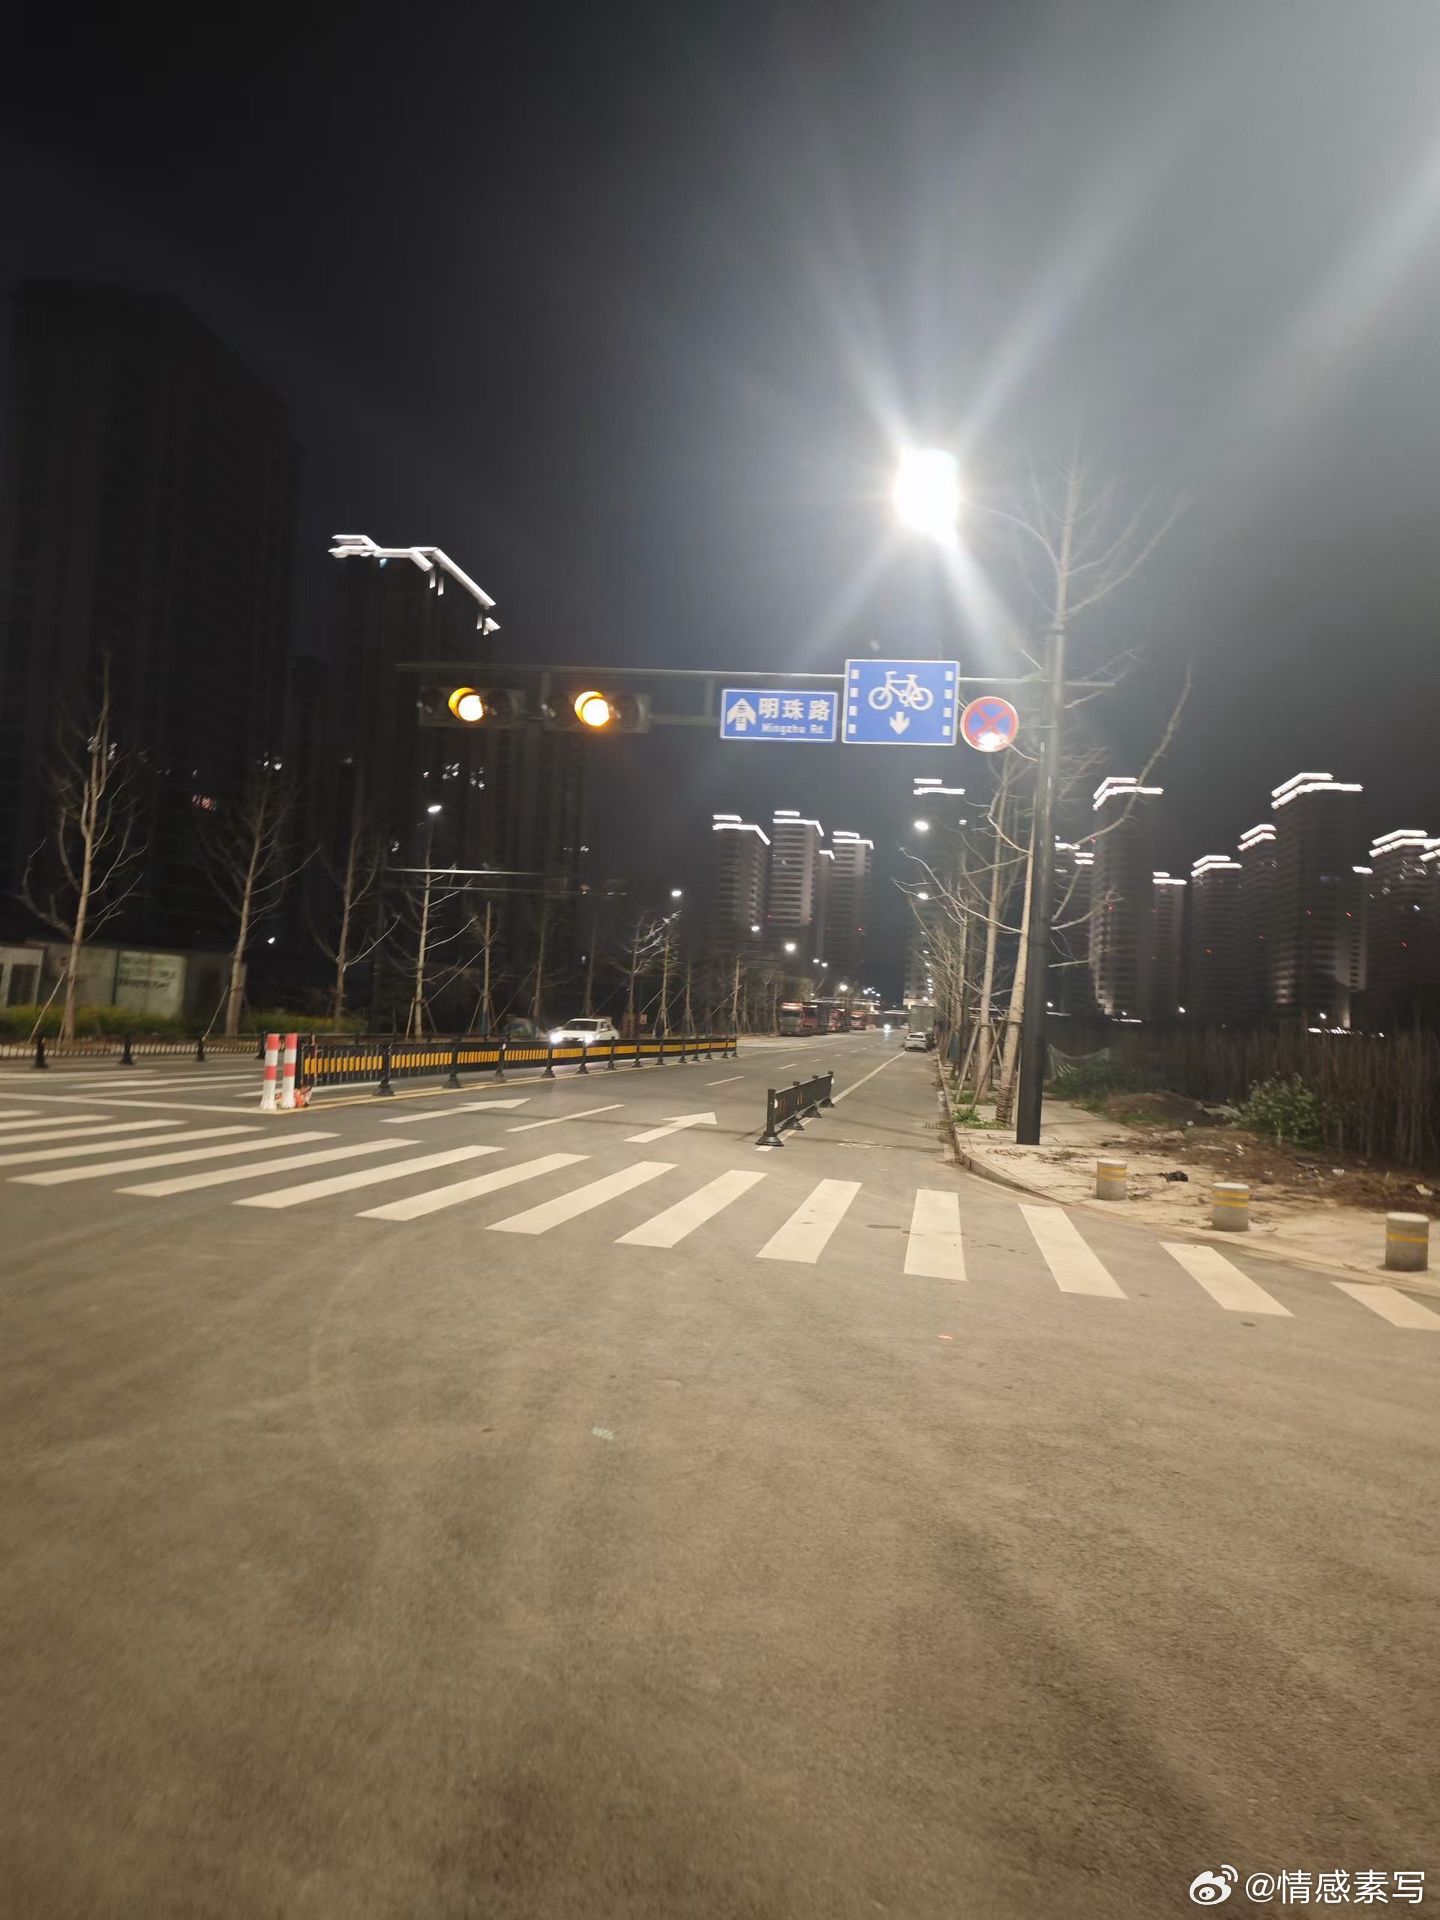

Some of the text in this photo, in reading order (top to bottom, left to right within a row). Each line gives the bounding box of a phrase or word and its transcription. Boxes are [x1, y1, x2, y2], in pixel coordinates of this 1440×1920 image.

[758, 698, 831, 721] 明珠路
[761, 723, 806, 736] Mingzhu
